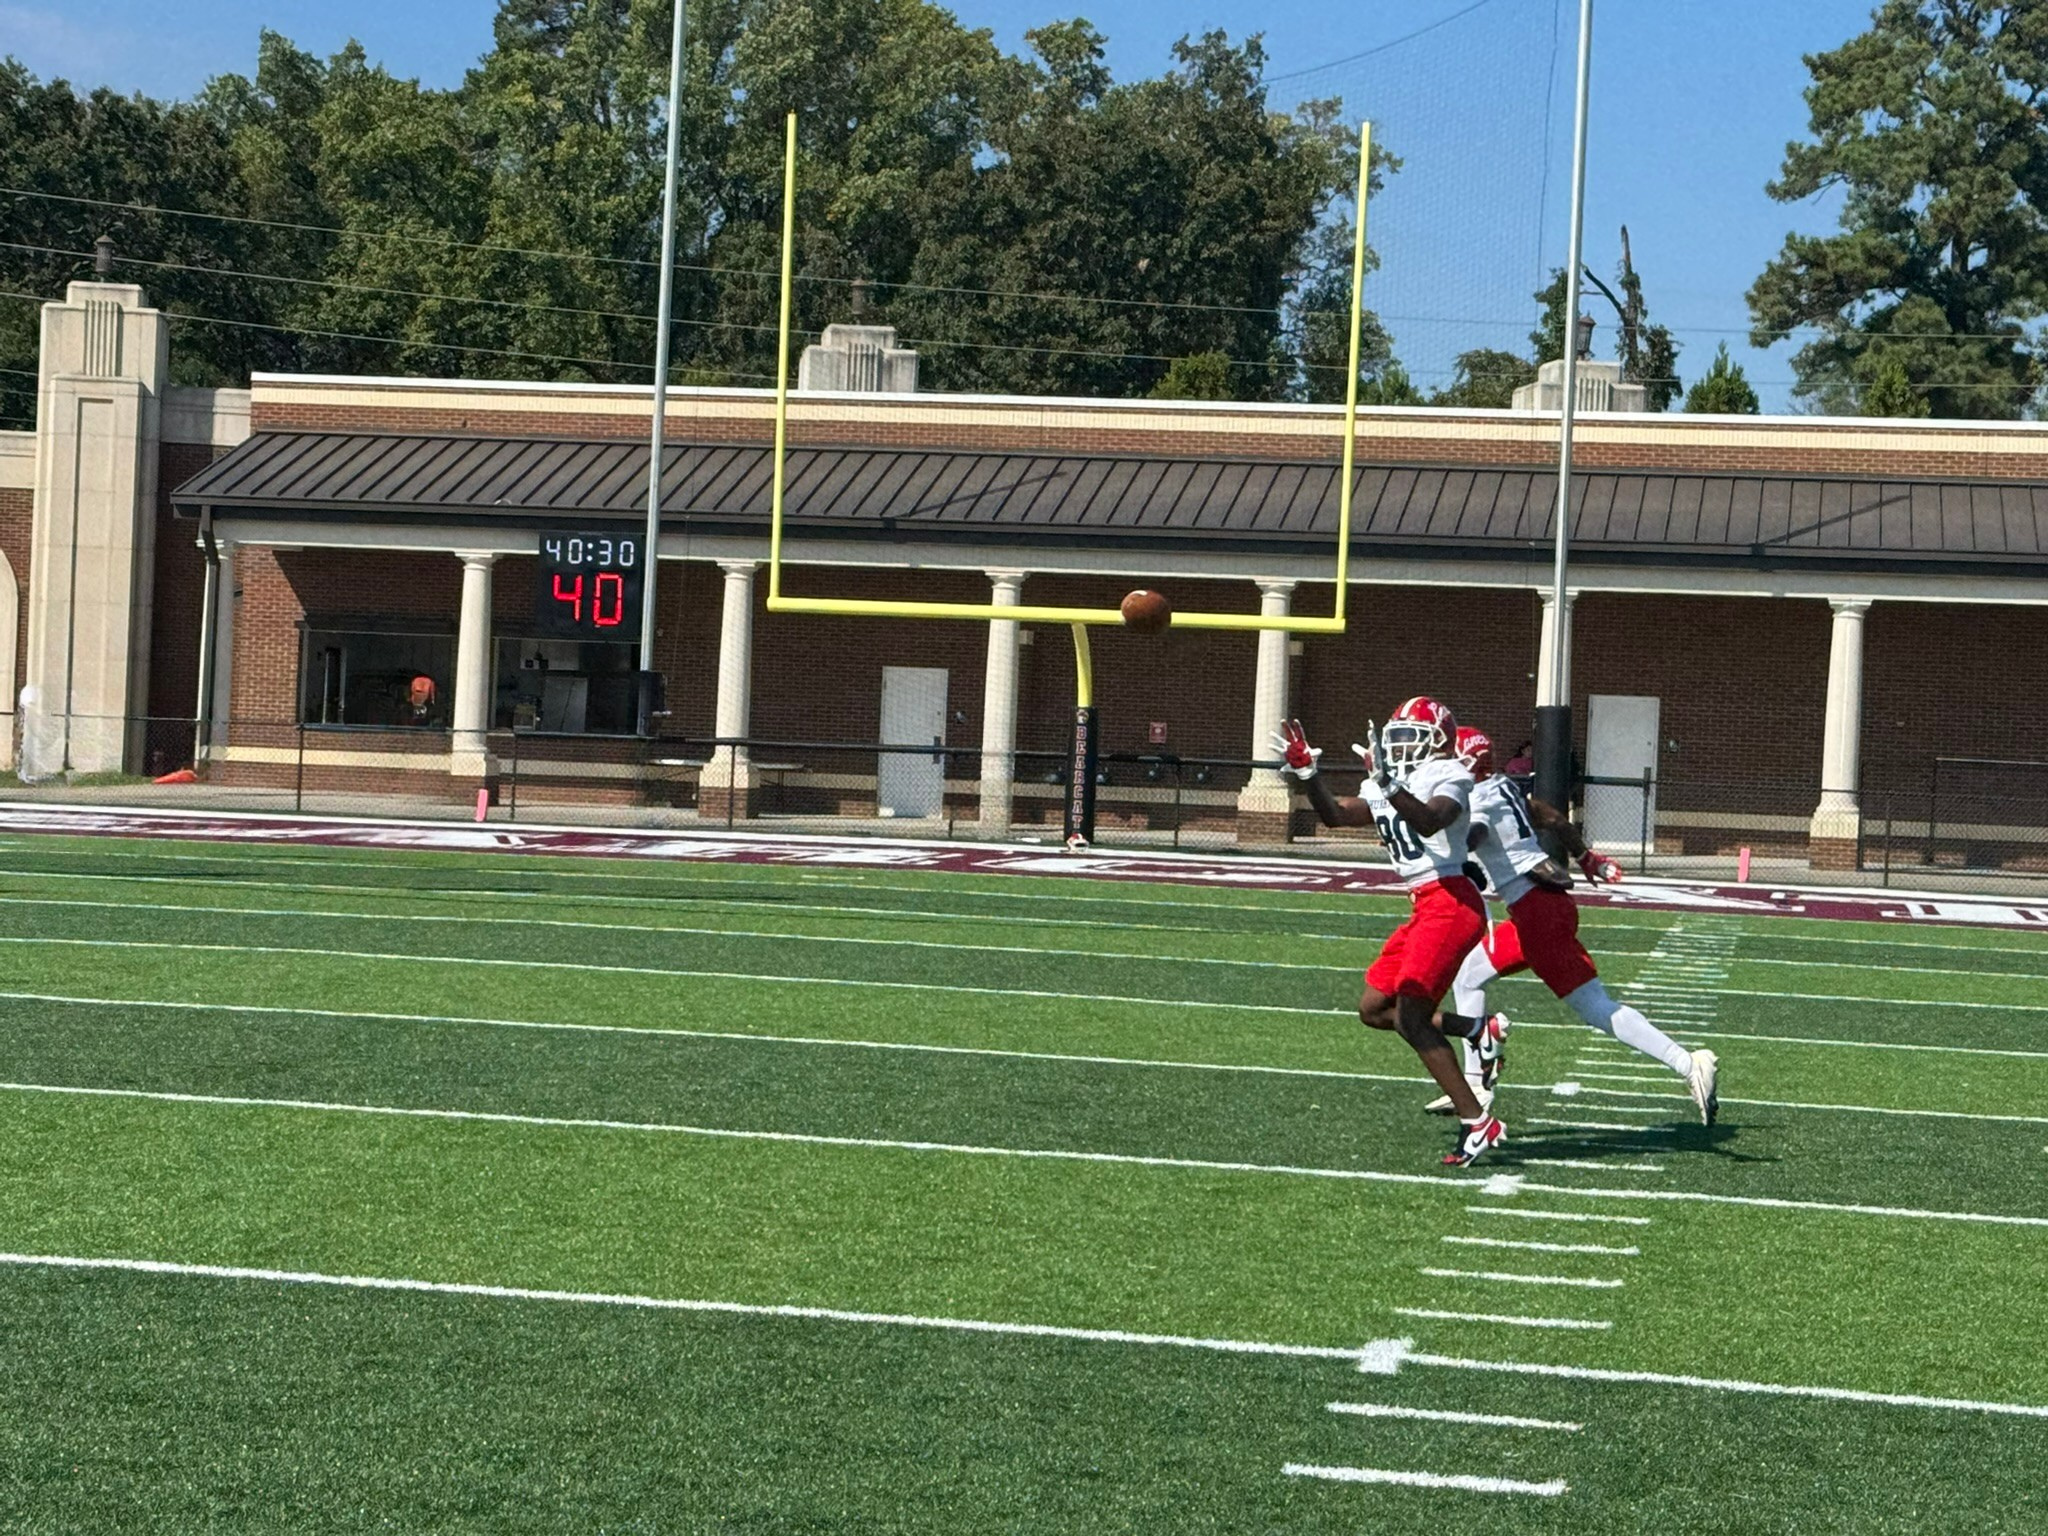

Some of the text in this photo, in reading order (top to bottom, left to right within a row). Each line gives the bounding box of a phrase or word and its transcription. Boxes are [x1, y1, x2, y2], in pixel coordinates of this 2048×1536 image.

[545, 538, 635, 566] 40:30
[552, 573, 623, 625] 40
[1072, 726, 1087, 830] BEARCAT
[1376, 815, 1426, 862] 80
